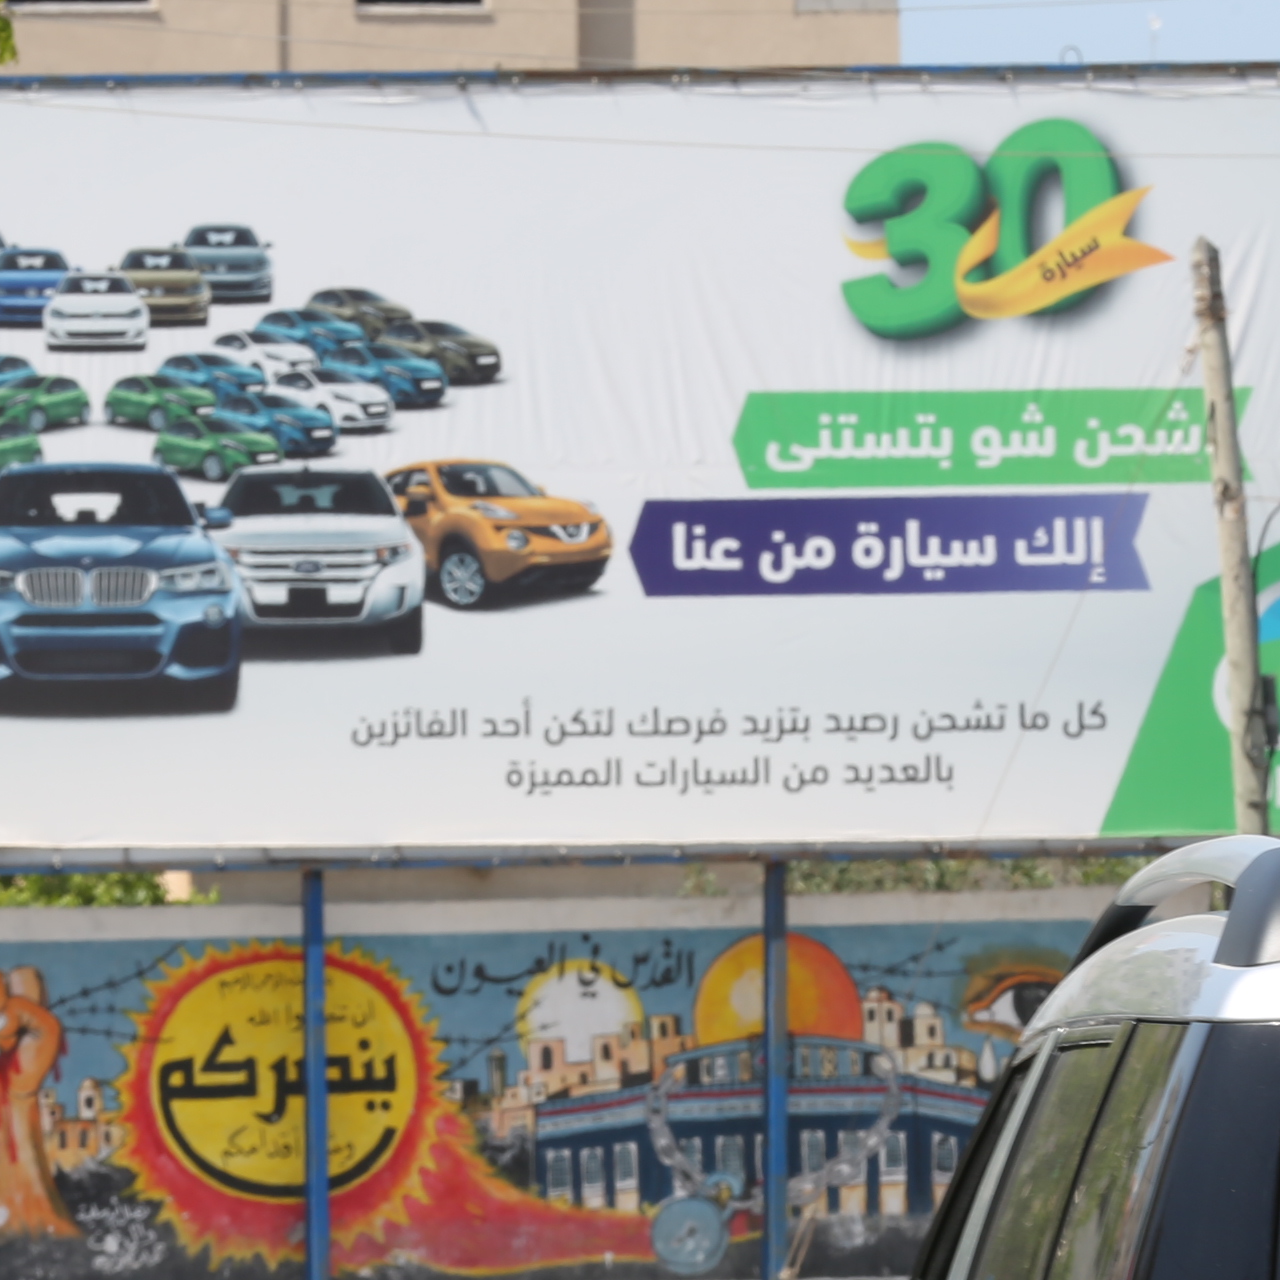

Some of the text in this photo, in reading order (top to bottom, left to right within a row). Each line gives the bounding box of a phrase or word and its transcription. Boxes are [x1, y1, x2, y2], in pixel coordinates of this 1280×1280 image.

[841, 117, 1122, 341] 30
[1041, 235, 1102, 284] سيارة
[765, 402, 1215, 473] شحن شو بتستنى
[671, 516, 1106, 584] إلك سيارة من عنا
[350, 695, 1109, 748] كل ما تشحن رصيد بتزيد فرصك لتكن أحد الفائزين
[504, 753, 955, 797] بالعديد من السيارات المميزة
[430, 932, 696, 1000] القدس في العيون
